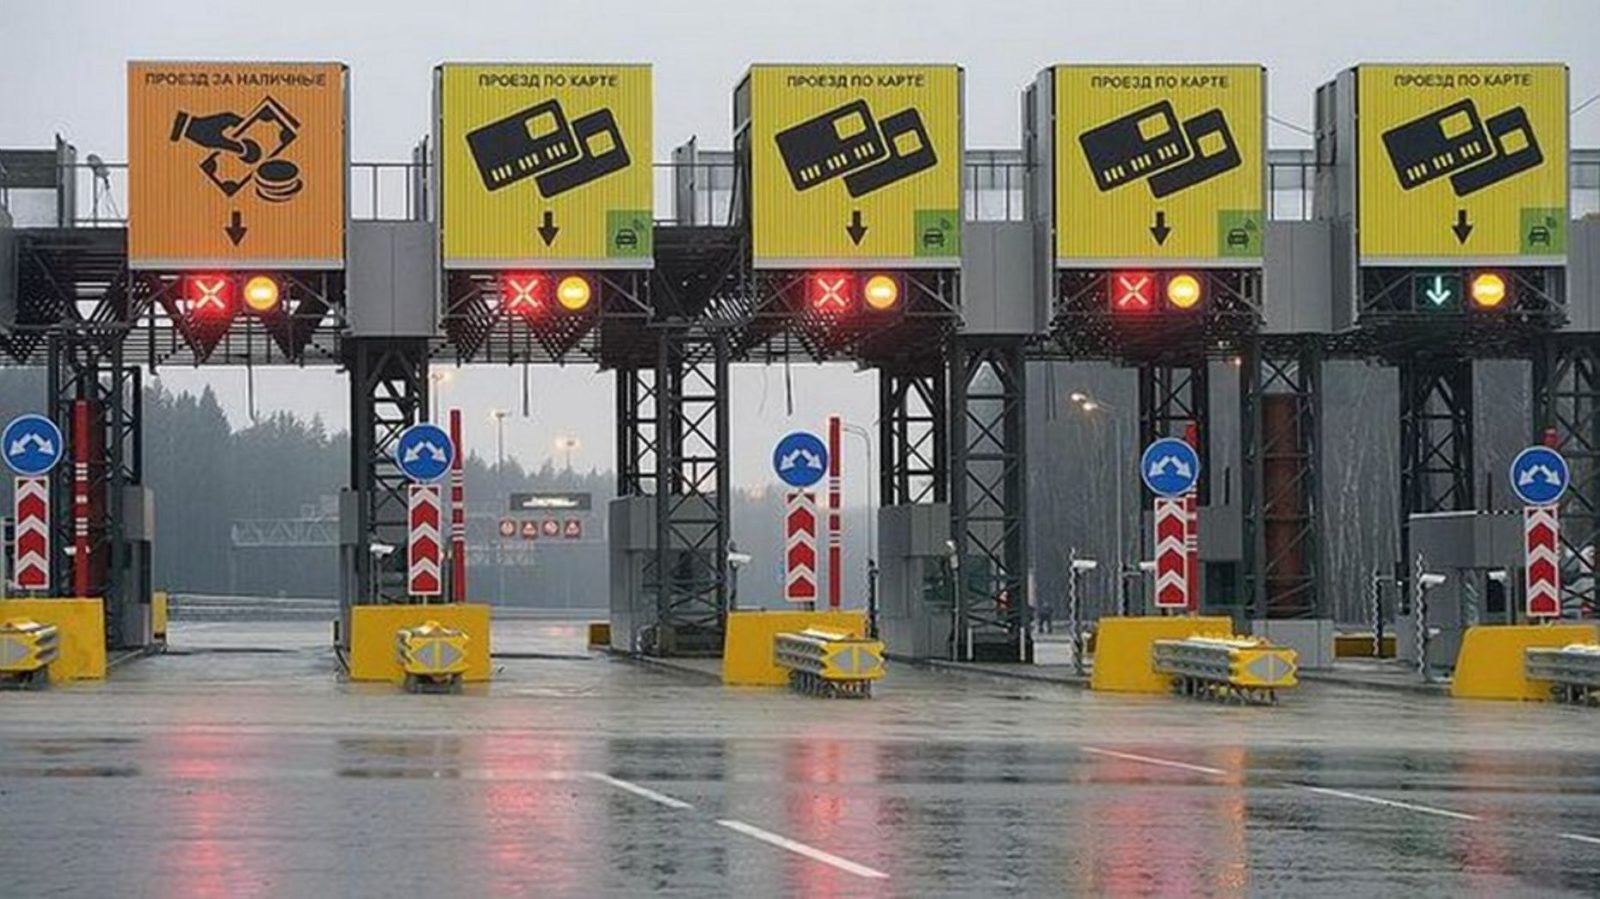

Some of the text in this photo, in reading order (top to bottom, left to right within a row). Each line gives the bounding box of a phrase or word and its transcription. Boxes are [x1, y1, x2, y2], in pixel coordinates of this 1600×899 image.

[145, 73, 326, 87] ПРОЕЗД ЗА НАЛИЧНЫЕ
[479, 74, 618, 88] ПРОЕЗД ПО КАРТЕ
[787, 75, 924, 88] ПРОЕЗД ПО КАРТЕ
[1091, 75, 1228, 88] ПРОЕЗД ПО КАРТЕ
[1394, 74, 1532, 88] ПРОЕЗД ПО КАРТЕ
